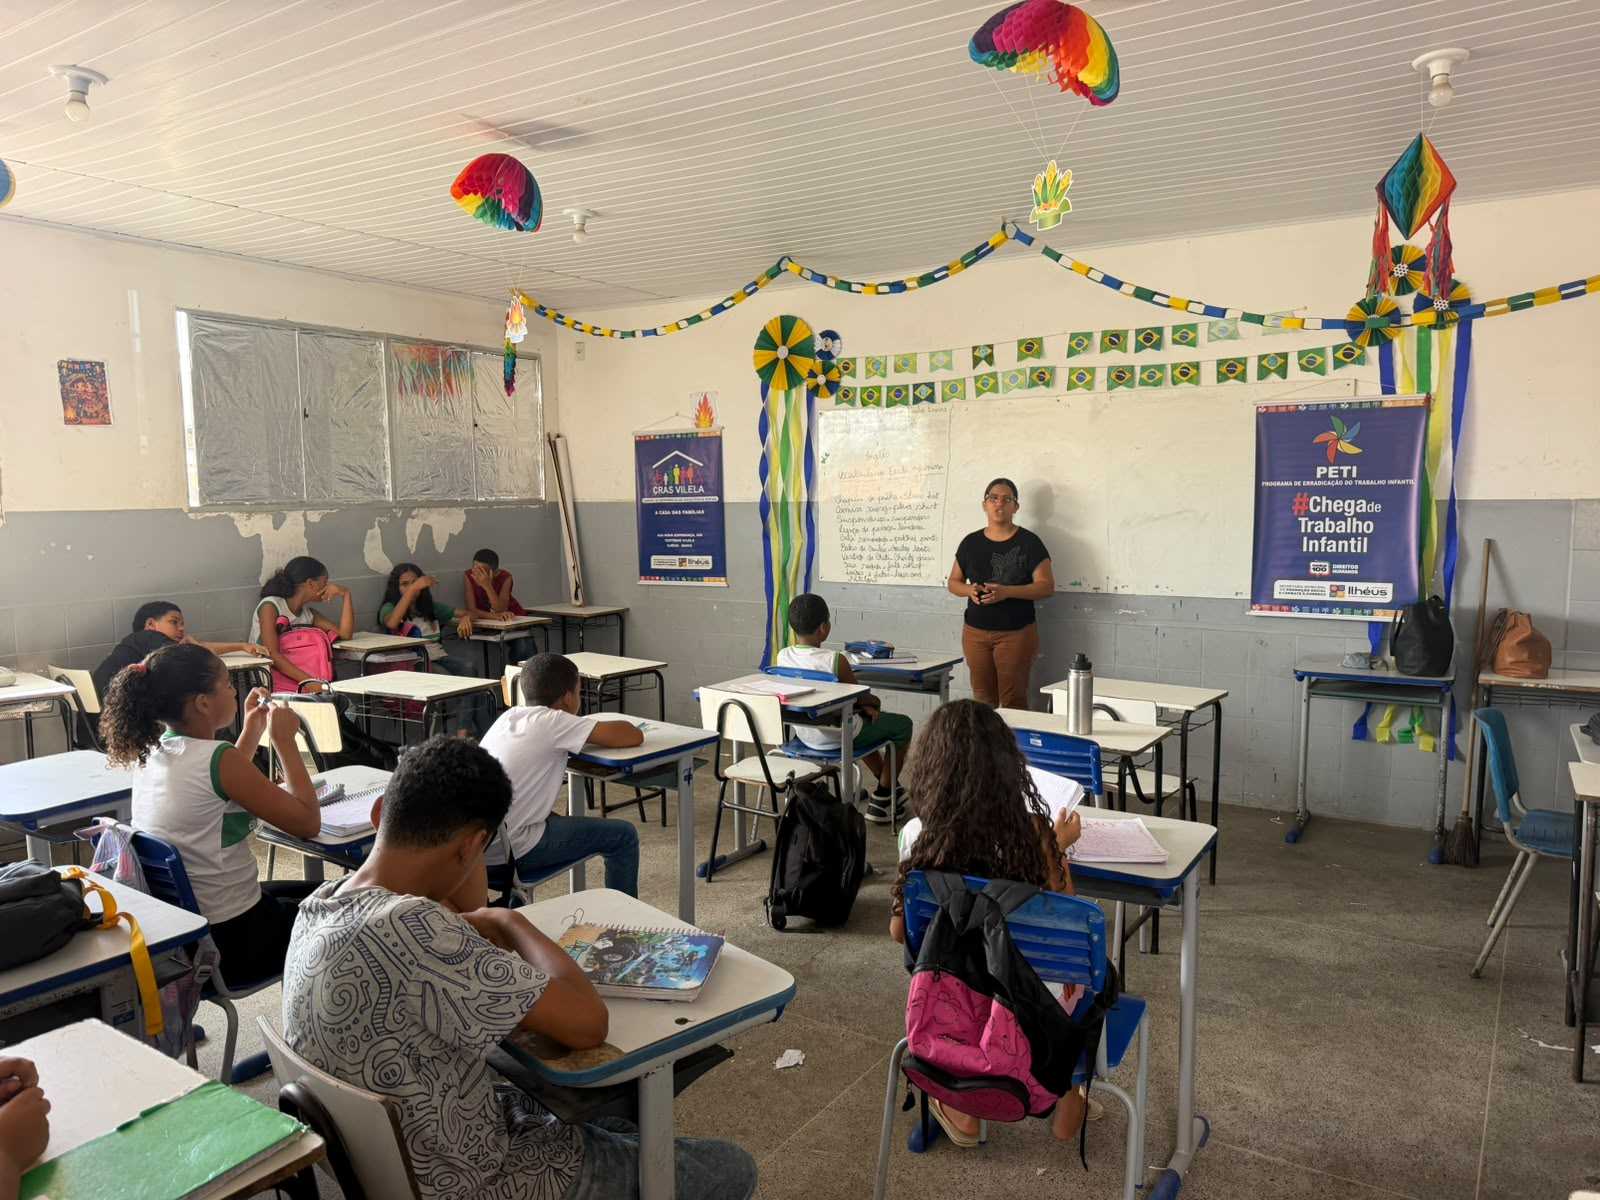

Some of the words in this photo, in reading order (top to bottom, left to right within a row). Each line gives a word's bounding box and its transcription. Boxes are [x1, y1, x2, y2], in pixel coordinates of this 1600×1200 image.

[1316, 466, 1357, 478] PETI
[1302, 479, 1343, 487] ERRADICAÇÃO
[652, 486, 674, 494] CRAS
[675, 485, 704, 494] VILELA
[1298, 517, 1374, 534] Trabalho
[1302, 536, 1368, 552] Infantil
[1348, 586, 1388, 596] Ilhéus
